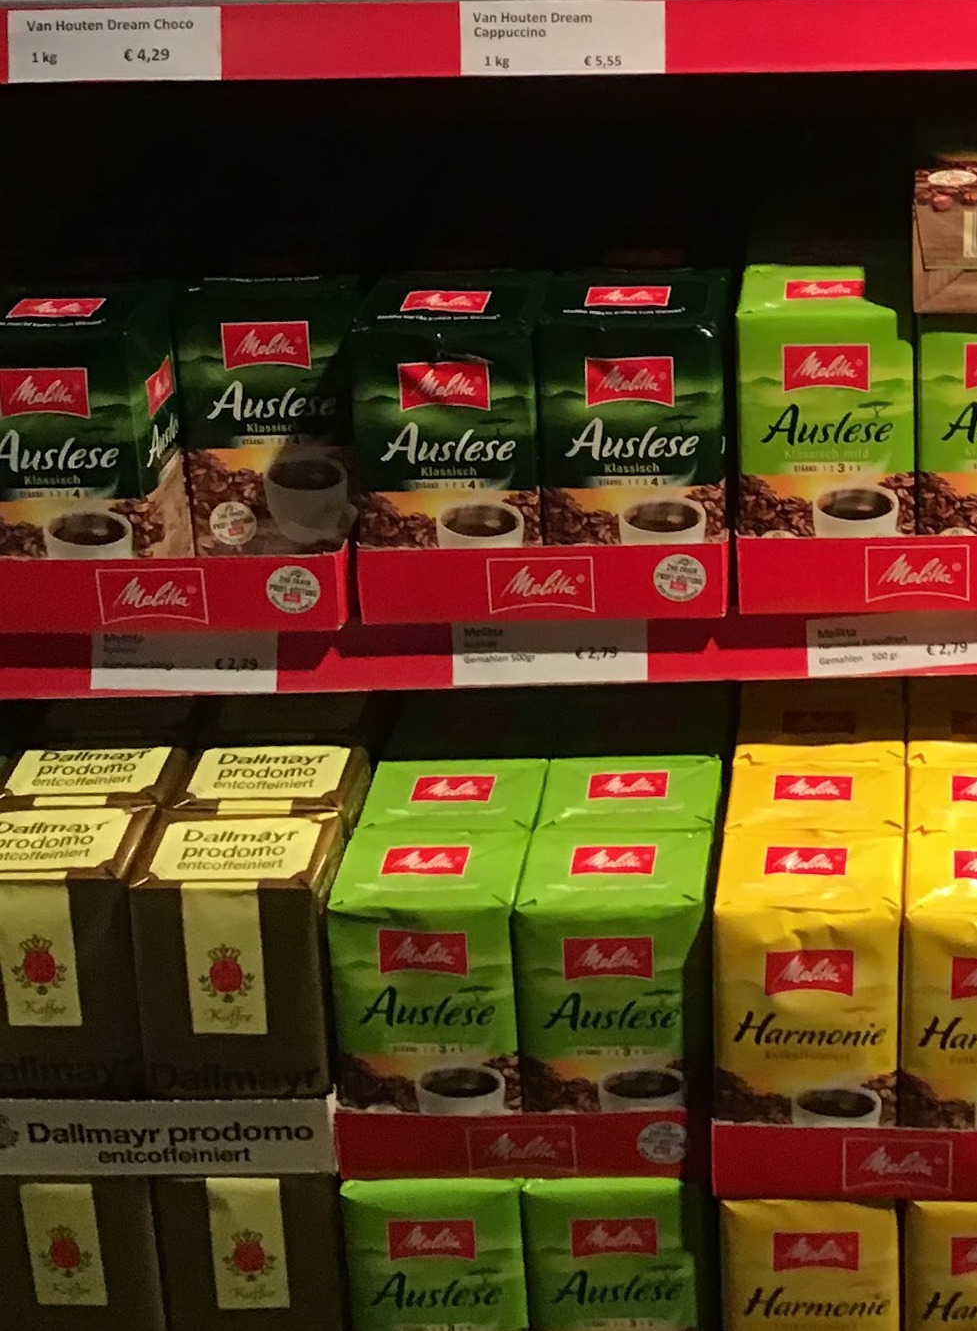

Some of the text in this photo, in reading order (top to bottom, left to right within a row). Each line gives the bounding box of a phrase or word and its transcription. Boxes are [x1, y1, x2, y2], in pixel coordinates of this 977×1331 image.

[26, 18, 194, 32] Van Houten Dream Choco
[473, 12, 593, 23] Van Houten Dream
[474, 27, 546, 40] Cappuccino
[32, 52, 58, 65] 1 kg
[124, 48, 170, 63] € 4,29
[485, 56, 510, 69] 1 kg
[584, 55, 622, 68] € 5,55
[234, 329, 298, 358] Melitta
[793, 350, 858, 379] Melitta
[594, 365, 661, 393] Melitta
[9, 375, 74, 405] Melitta
[206, 380, 338, 421] Auslese
[761, 403, 894, 446] Auslese
[381, 421, 517, 464] Auslese
[565, 417, 700, 459] Auslese
[421, 466, 477, 478] Klassisch
[604, 462, 660, 474] Klassisch
[877, 553, 954, 586] Melitta
[501, 565, 579, 597] Melitta
[113, 577, 191, 608] Melitta
[926, 642, 968, 657] € 2,79
[217, 753, 330, 766] Dallmayr
[36, 762, 137, 777] prodomo
[217, 766, 317, 779] prodomo
[31, 775, 133, 787] entcoffeiniert
[213, 779, 314, 790] entcoffeiniert
[182, 829, 300, 843] Dallmayr
[181, 844, 286, 859] prodomo
[176, 859, 284, 871] entcoffeiniert
[359, 985, 497, 1031] Auslese
[543, 991, 681, 1034] Auslese
[734, 1011, 887, 1048] Harmonie
[27, 1122, 314, 1148] Dallmayr prodomo
[97, 1146, 251, 1164] entcoffeiniert
[744, 1286, 891, 1319] Harmonie
